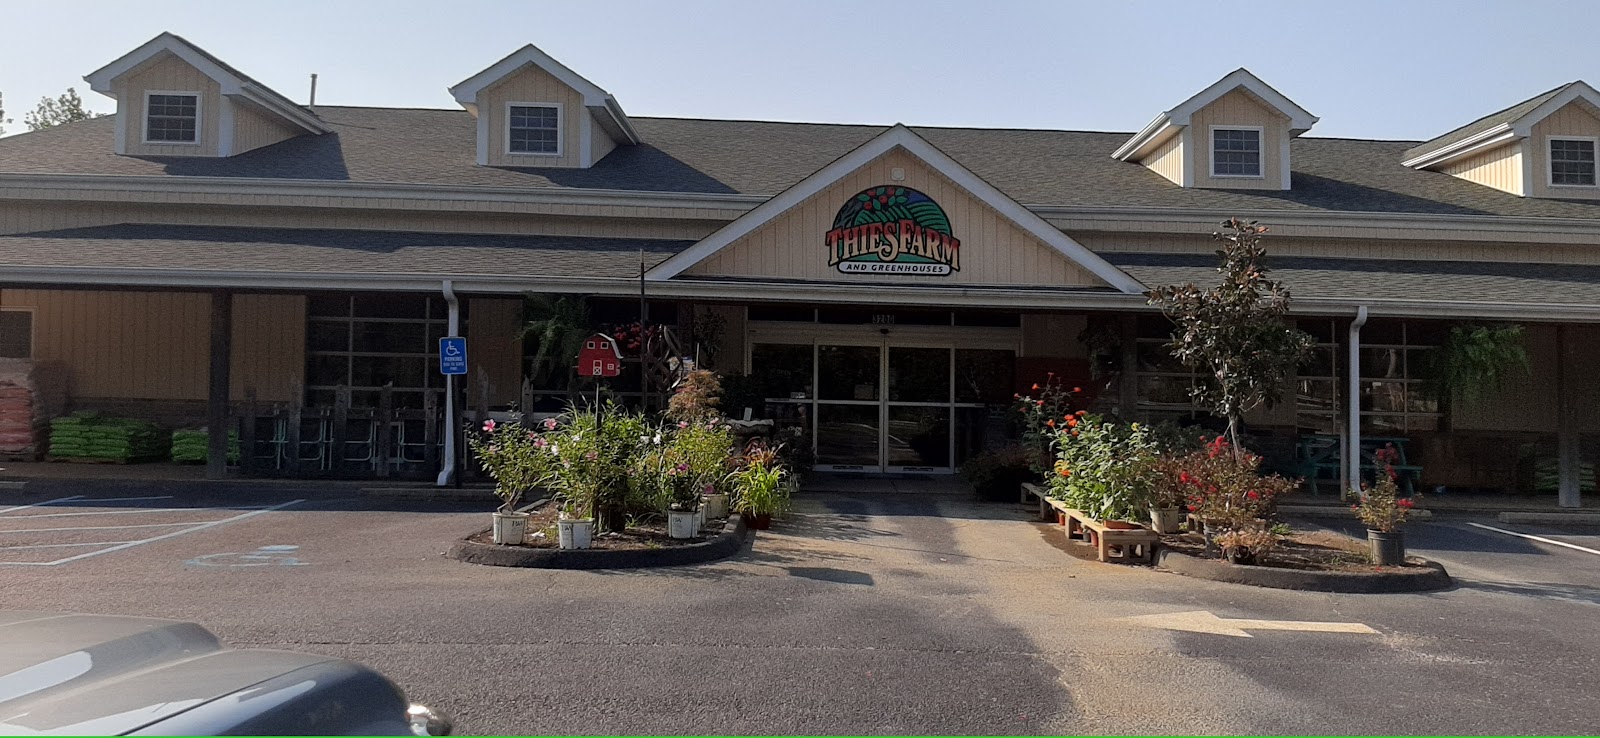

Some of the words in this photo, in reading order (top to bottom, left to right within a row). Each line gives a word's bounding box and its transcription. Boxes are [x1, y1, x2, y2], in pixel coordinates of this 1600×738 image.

[825, 221, 900, 266] THIES
[898, 219, 960, 271] FARM
[846, 263, 868, 271] AND
[871, 264, 944, 273] GREENHOUSES
